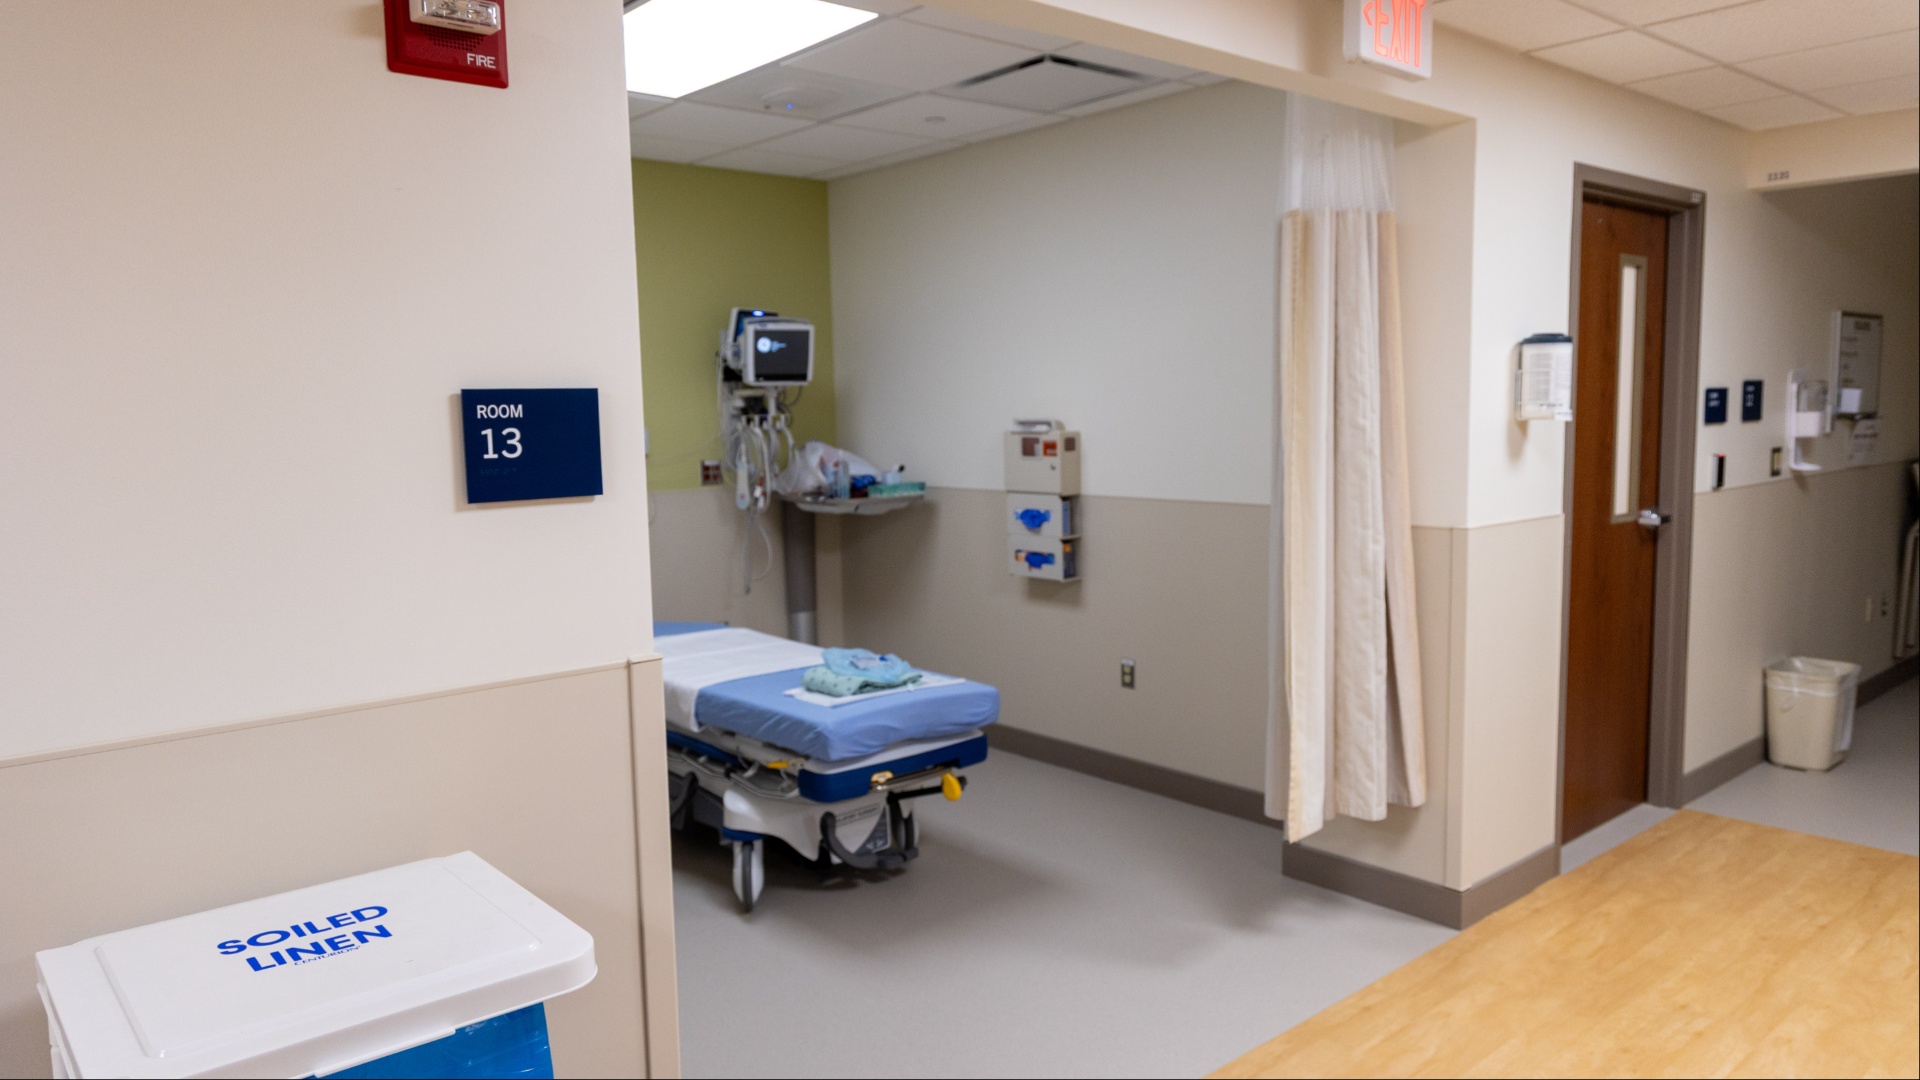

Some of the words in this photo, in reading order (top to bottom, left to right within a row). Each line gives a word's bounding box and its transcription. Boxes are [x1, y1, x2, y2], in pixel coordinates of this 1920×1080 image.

[1374, 0, 1426, 68] EXIT
[466, 53, 496, 69] FIRE
[476, 404, 523, 419] ROOM
[480, 427, 523, 459] 13
[216, 905, 388, 955] SOILED
[245, 924, 393, 972] LINEN
